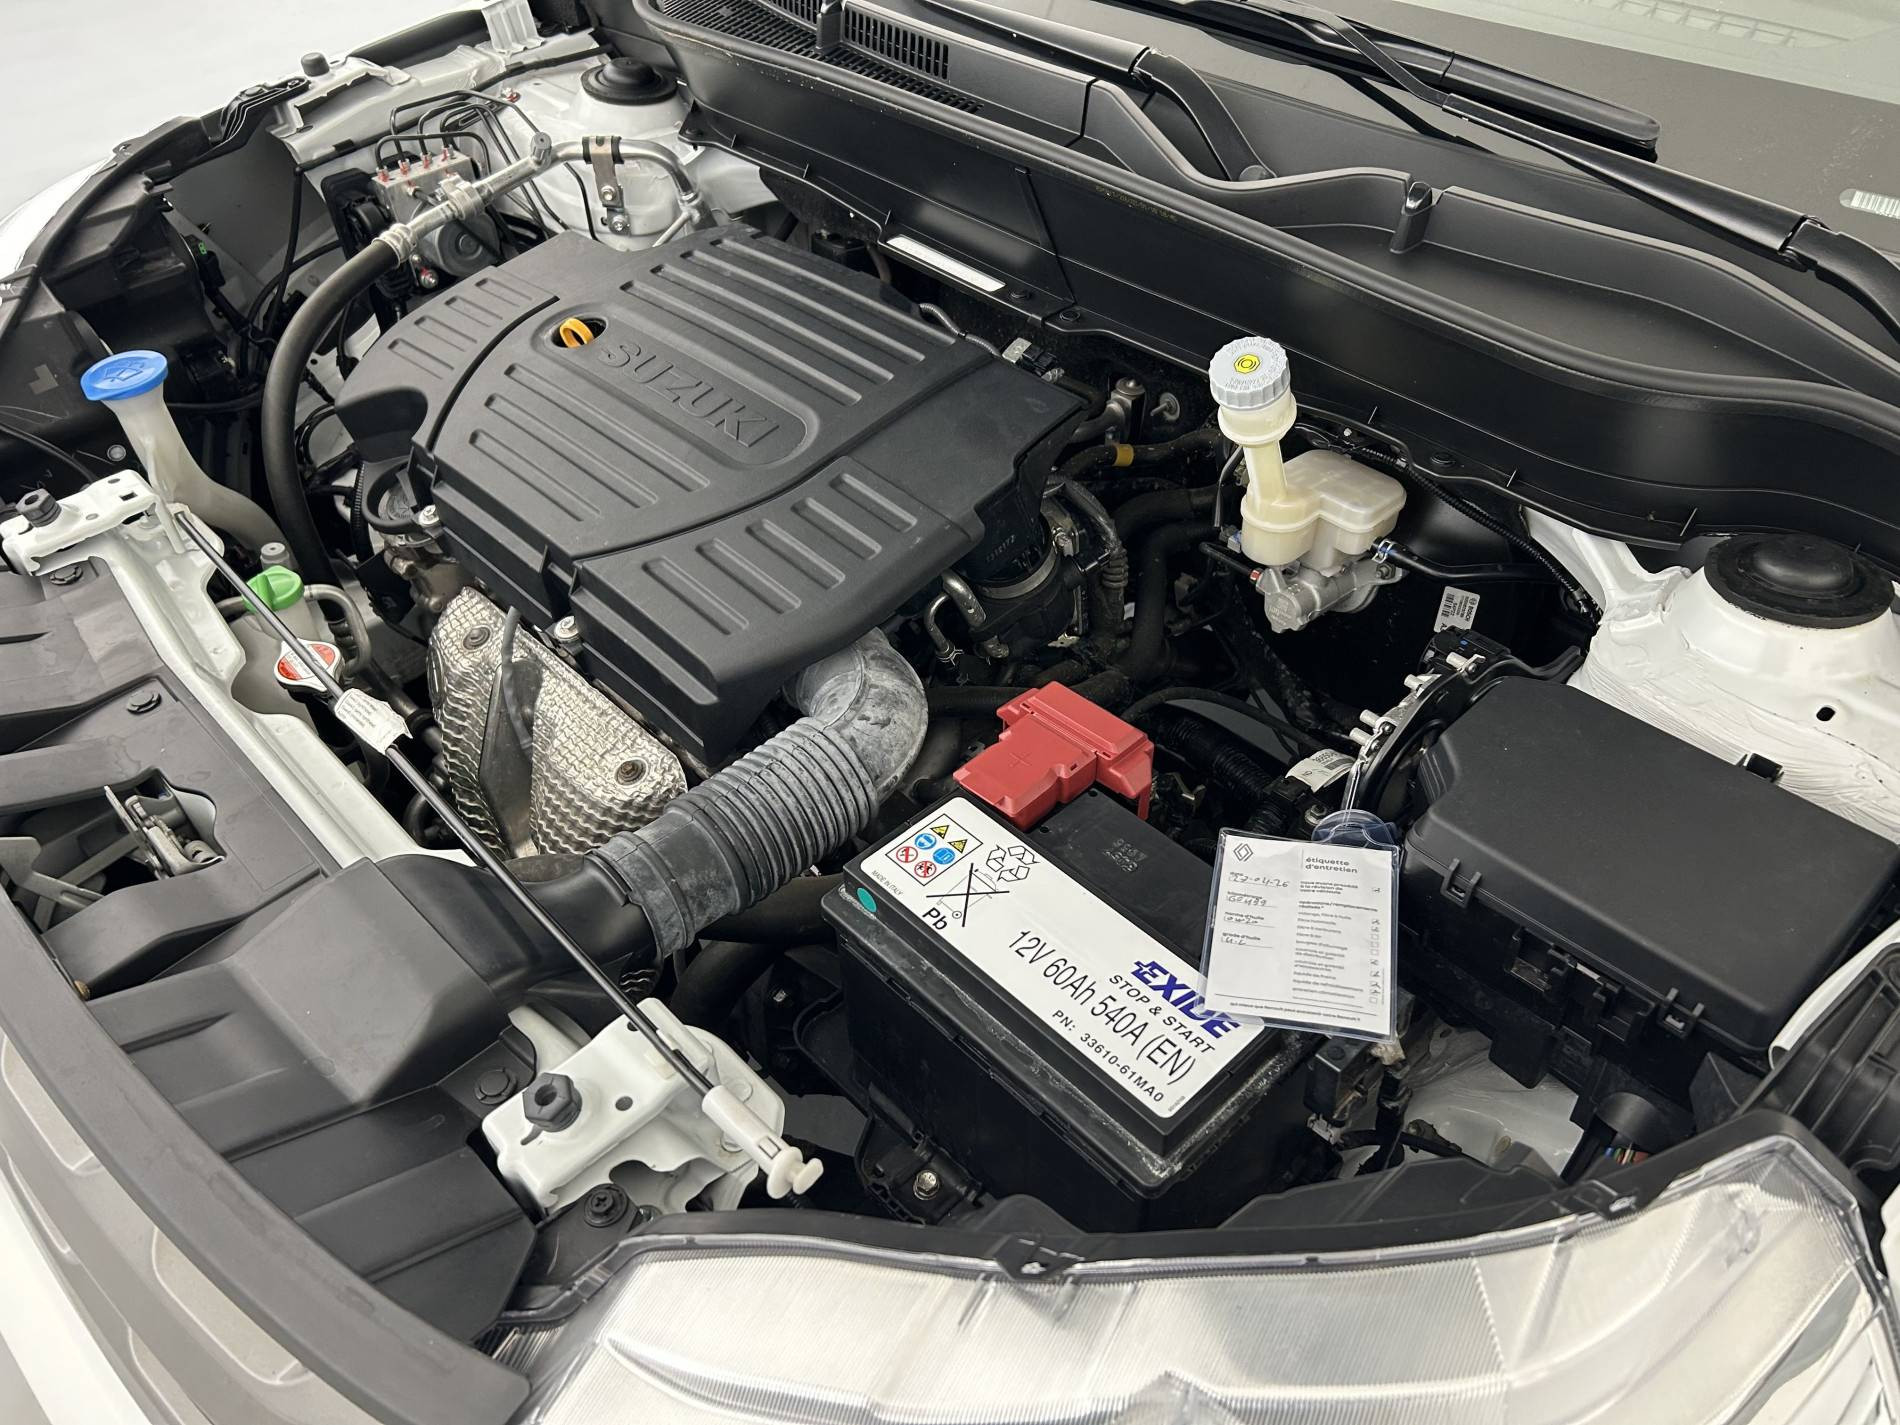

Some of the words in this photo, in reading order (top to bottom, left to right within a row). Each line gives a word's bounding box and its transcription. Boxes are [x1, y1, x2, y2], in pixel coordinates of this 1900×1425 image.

[600, 342, 780, 448] SUZUKI
[871, 870, 887, 882] MADE
[888, 883, 904, 897] ITALY
[1305, 857, 1350, 867] étiquette
[922, 907, 948, 930] Pb
[1008, 930, 1056, 964] 12V
[1043, 958, 1096, 1006] 60Ah
[1091, 994, 1149, 1047] 540A
[1136, 1033, 1196, 1086] (EN)
[1109, 974, 1150, 1004] STOP
[1149, 1006, 1162, 1016] &
[1162, 1015, 1216, 1054] START
[1131, 960, 1241, 1039] EXIDE
[1052, 1009, 1076, 1031] PN:
[1080, 1032, 1165, 1102] 33610-61MA0
